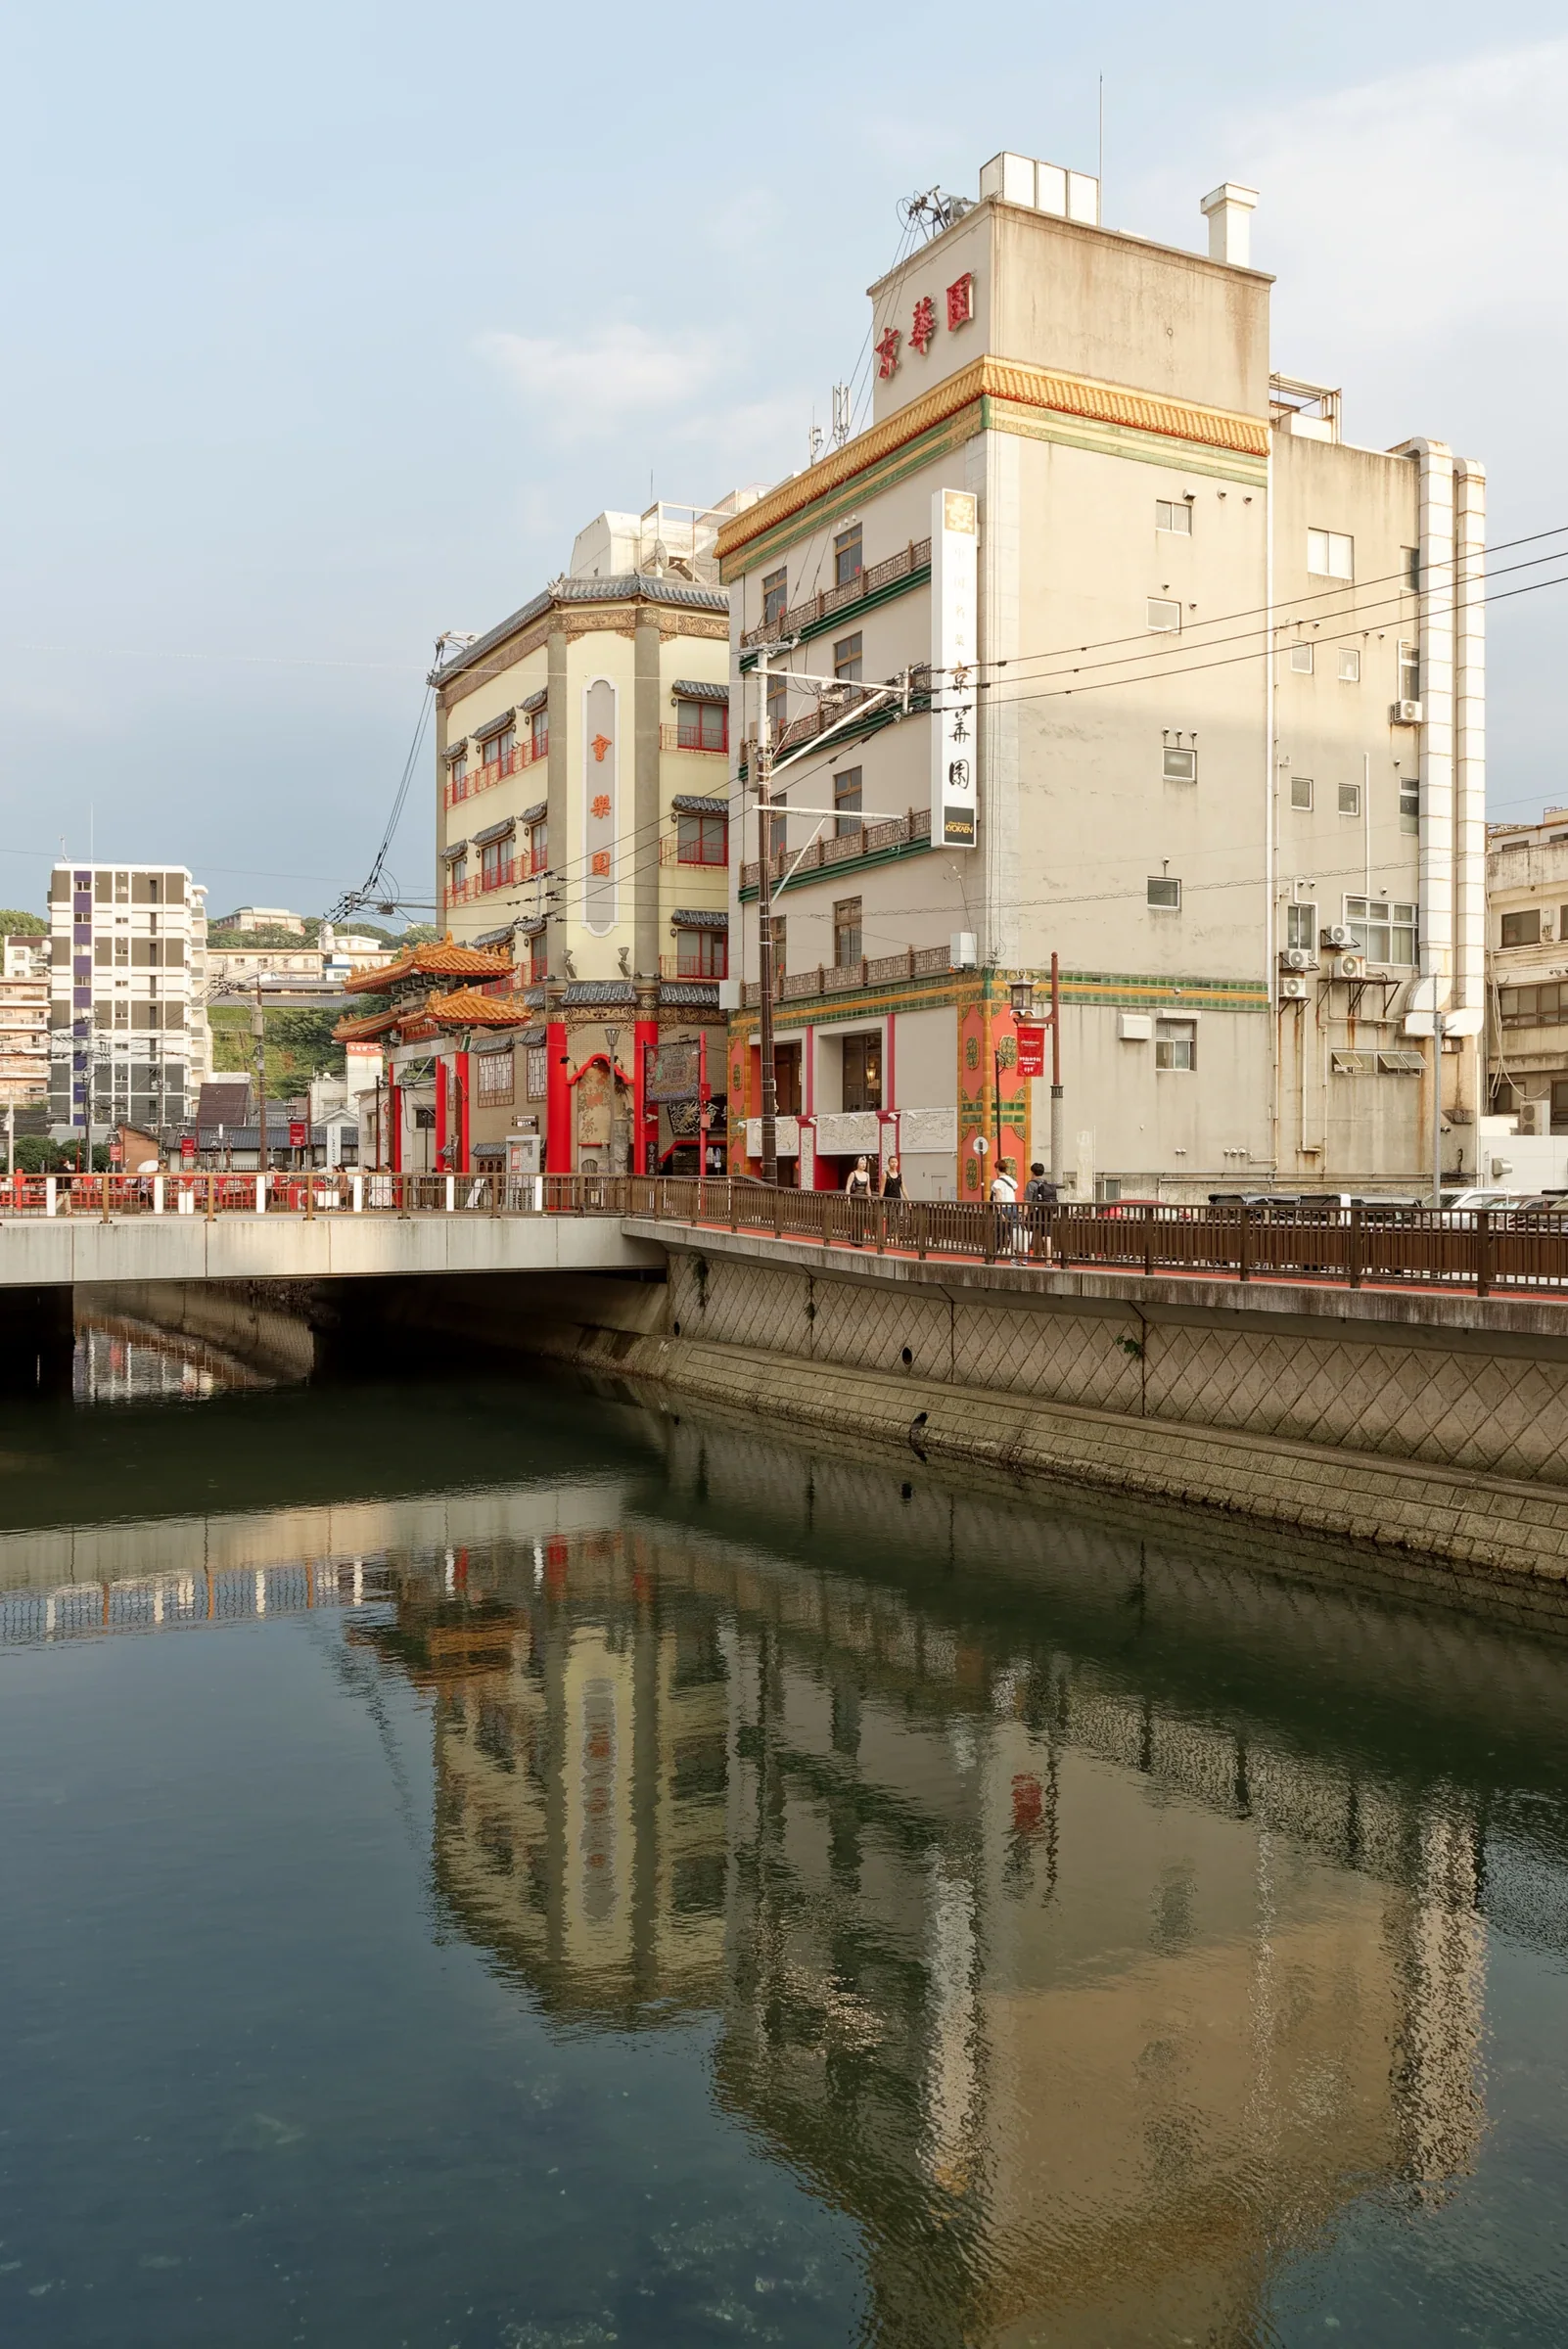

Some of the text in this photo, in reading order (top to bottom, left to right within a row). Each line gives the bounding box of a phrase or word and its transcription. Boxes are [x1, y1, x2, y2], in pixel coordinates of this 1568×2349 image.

[874, 272, 973, 380] 京華園
[590, 733, 612, 878] 會樂園
[945, 824, 974, 834] KYOKAEN
